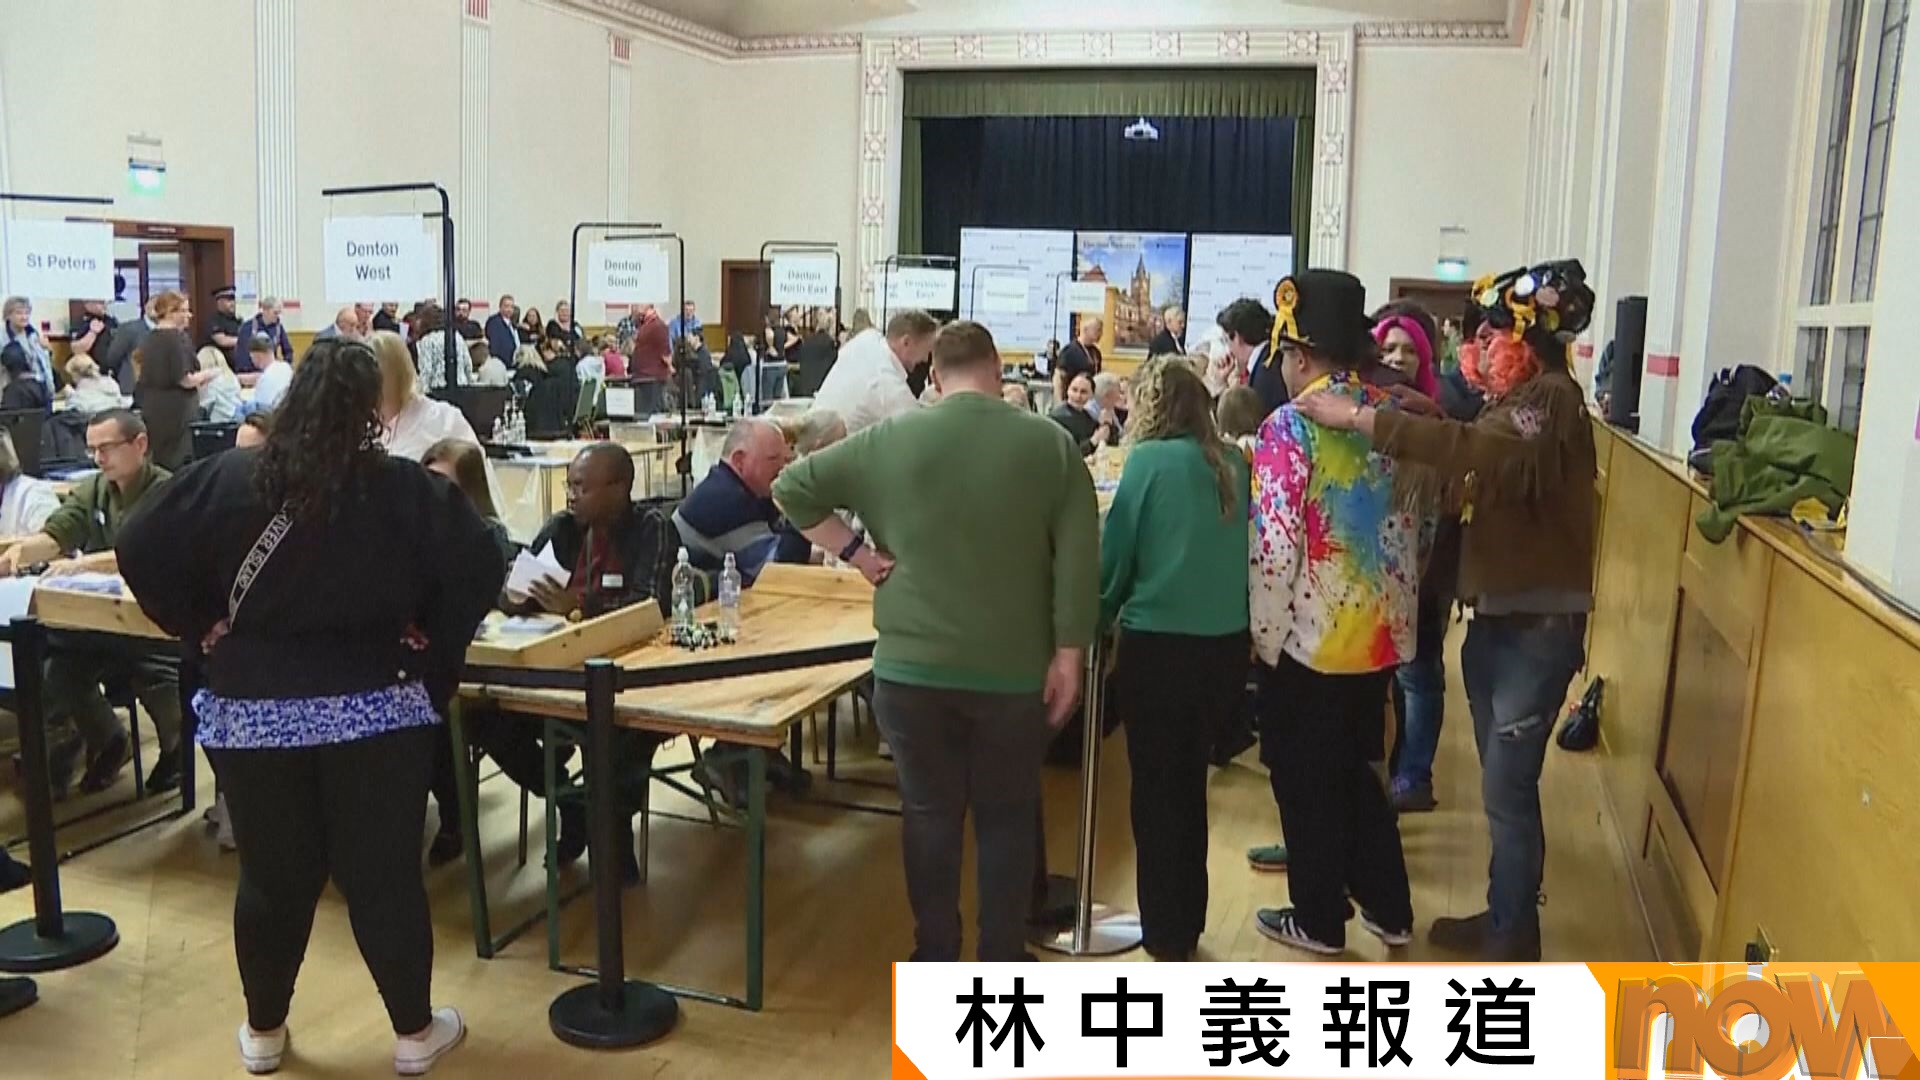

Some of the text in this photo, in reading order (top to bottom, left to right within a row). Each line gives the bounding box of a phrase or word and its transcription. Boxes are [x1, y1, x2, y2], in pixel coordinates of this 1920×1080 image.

[346, 241, 399, 258] Denton
[26, 253, 97, 272] St Peters
[604, 258, 642, 273] Denton
[355, 264, 392, 281] West
[608, 275, 638, 288] South
[238, 549, 266, 589] ISLAND
